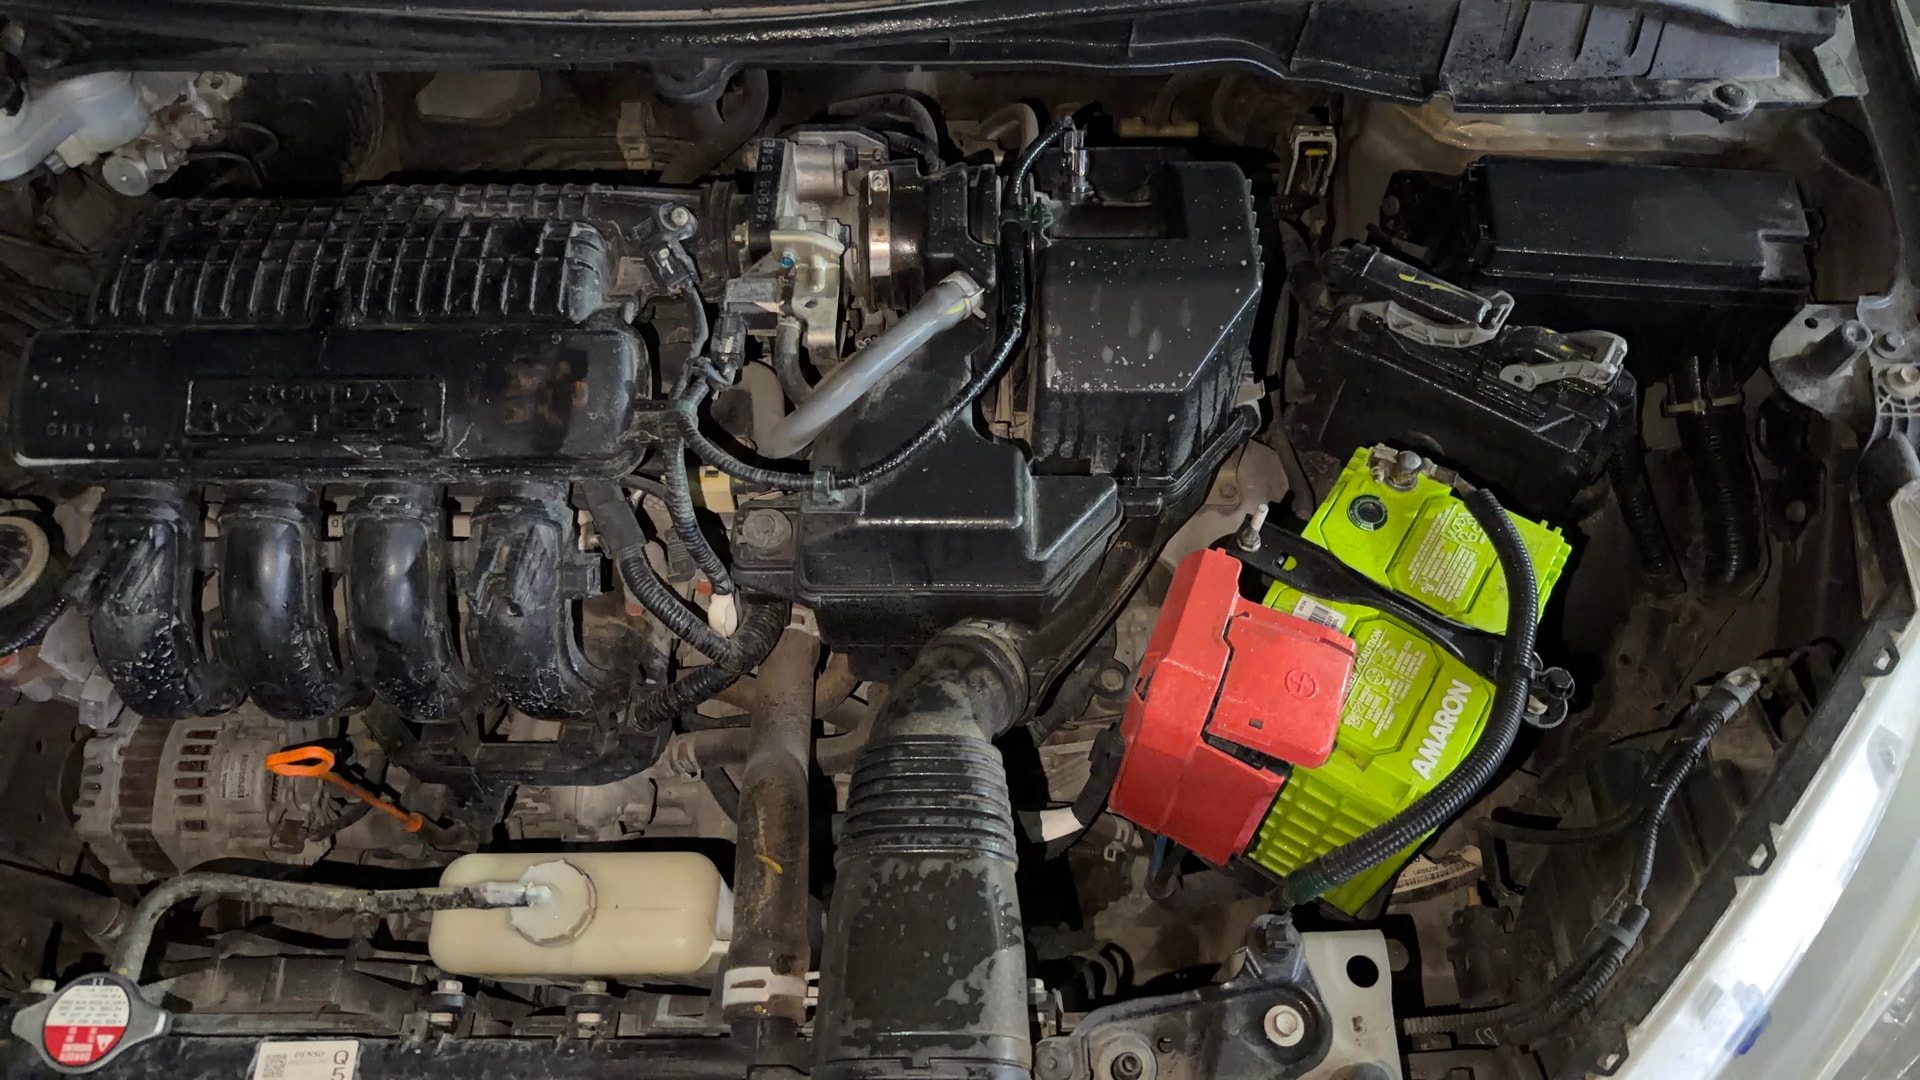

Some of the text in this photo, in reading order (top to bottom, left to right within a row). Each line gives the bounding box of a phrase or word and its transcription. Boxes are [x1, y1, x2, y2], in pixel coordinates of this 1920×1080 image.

[45, 421, 94, 438] CITY
[1357, 628, 1383, 665] CAUTION
[1411, 679, 1473, 780] AMARON
[294, 1050, 325, 1058] DENSO
[333, 1049, 349, 1065] Q
[331, 1067, 346, 1080] 5
